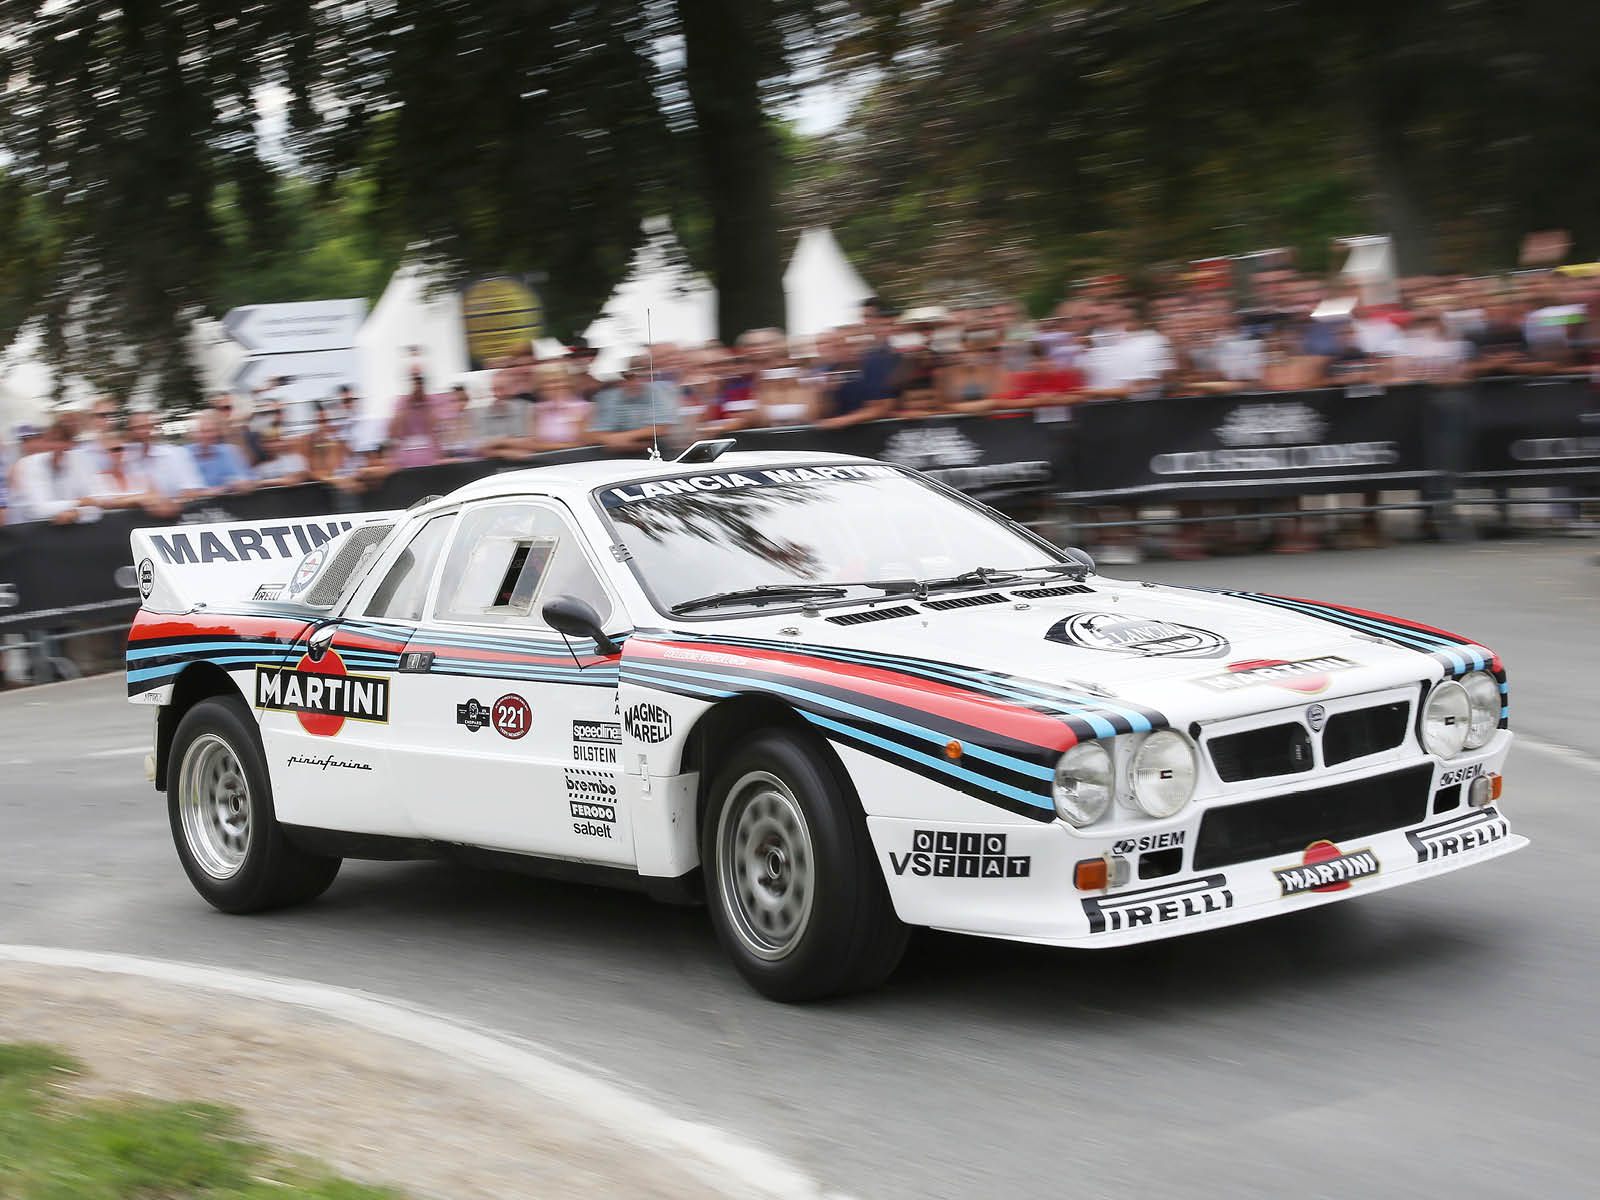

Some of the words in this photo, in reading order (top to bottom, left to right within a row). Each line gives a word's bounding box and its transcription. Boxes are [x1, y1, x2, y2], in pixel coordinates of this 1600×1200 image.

[610, 473, 762, 503] LANCIA
[252, 583, 287, 601] PIRELLI
[259, 671, 385, 716] MARTINI
[498, 705, 524, 729] 221
[624, 702, 673, 730] MAGNETI
[572, 723, 619, 740] speedline
[624, 717, 673, 743] MARELLI
[287, 754, 373, 771] pininfarina
[573, 745, 617, 764] BILSTEIN
[1454, 762, 1483, 783] SIEM
[565, 775, 617, 796] brembo
[571, 803, 615, 821] FERODO
[573, 821, 612, 839] sabelt
[1138, 830, 1186, 851] SIEM
[1404, 806, 1507, 864] PIRELLI
[915, 832, 1004, 853] OLIO
[1280, 853, 1377, 891] MARTINI
[1080, 873, 1233, 934] PIRELLI
